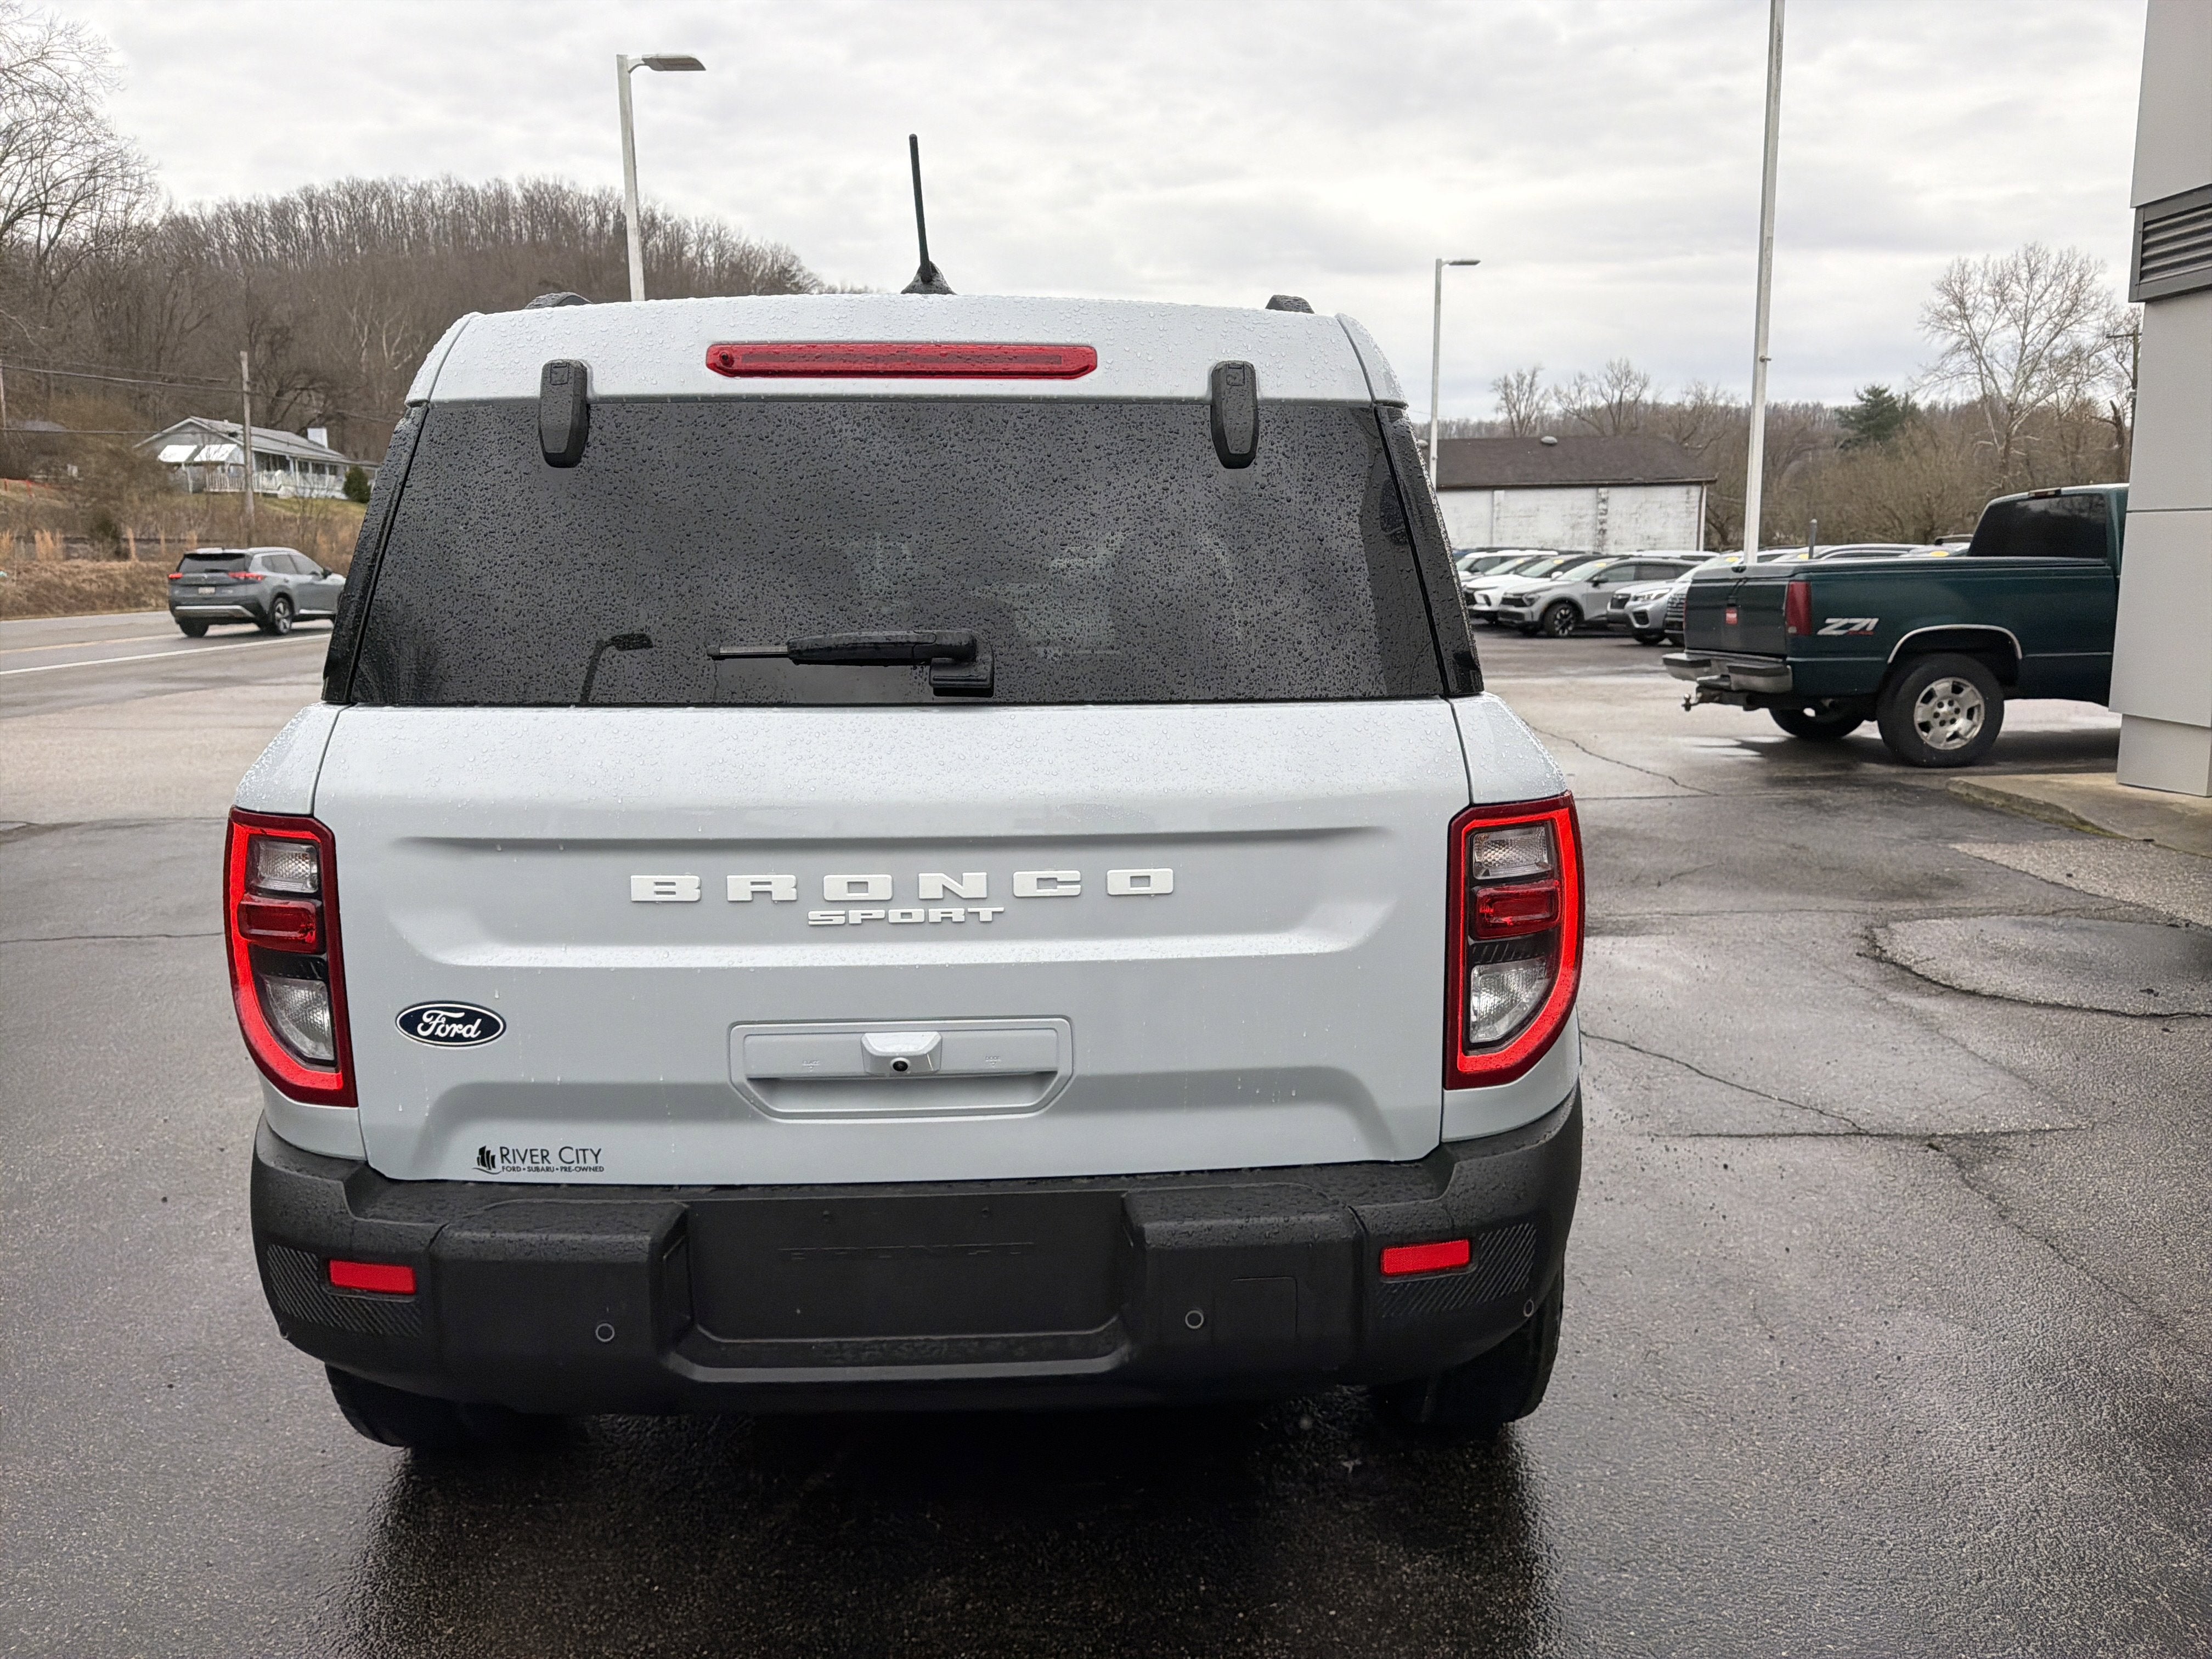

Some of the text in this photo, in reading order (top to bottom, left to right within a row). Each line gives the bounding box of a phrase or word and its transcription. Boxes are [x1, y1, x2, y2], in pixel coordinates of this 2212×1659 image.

[1816, 618, 1879, 635] Z71
[631, 868, 1174, 901] BRONCO
[808, 907, 1005, 925] SPORT
[417, 1010, 482, 1038] Ford
[500, 1146, 602, 1164] RIVER CITY
